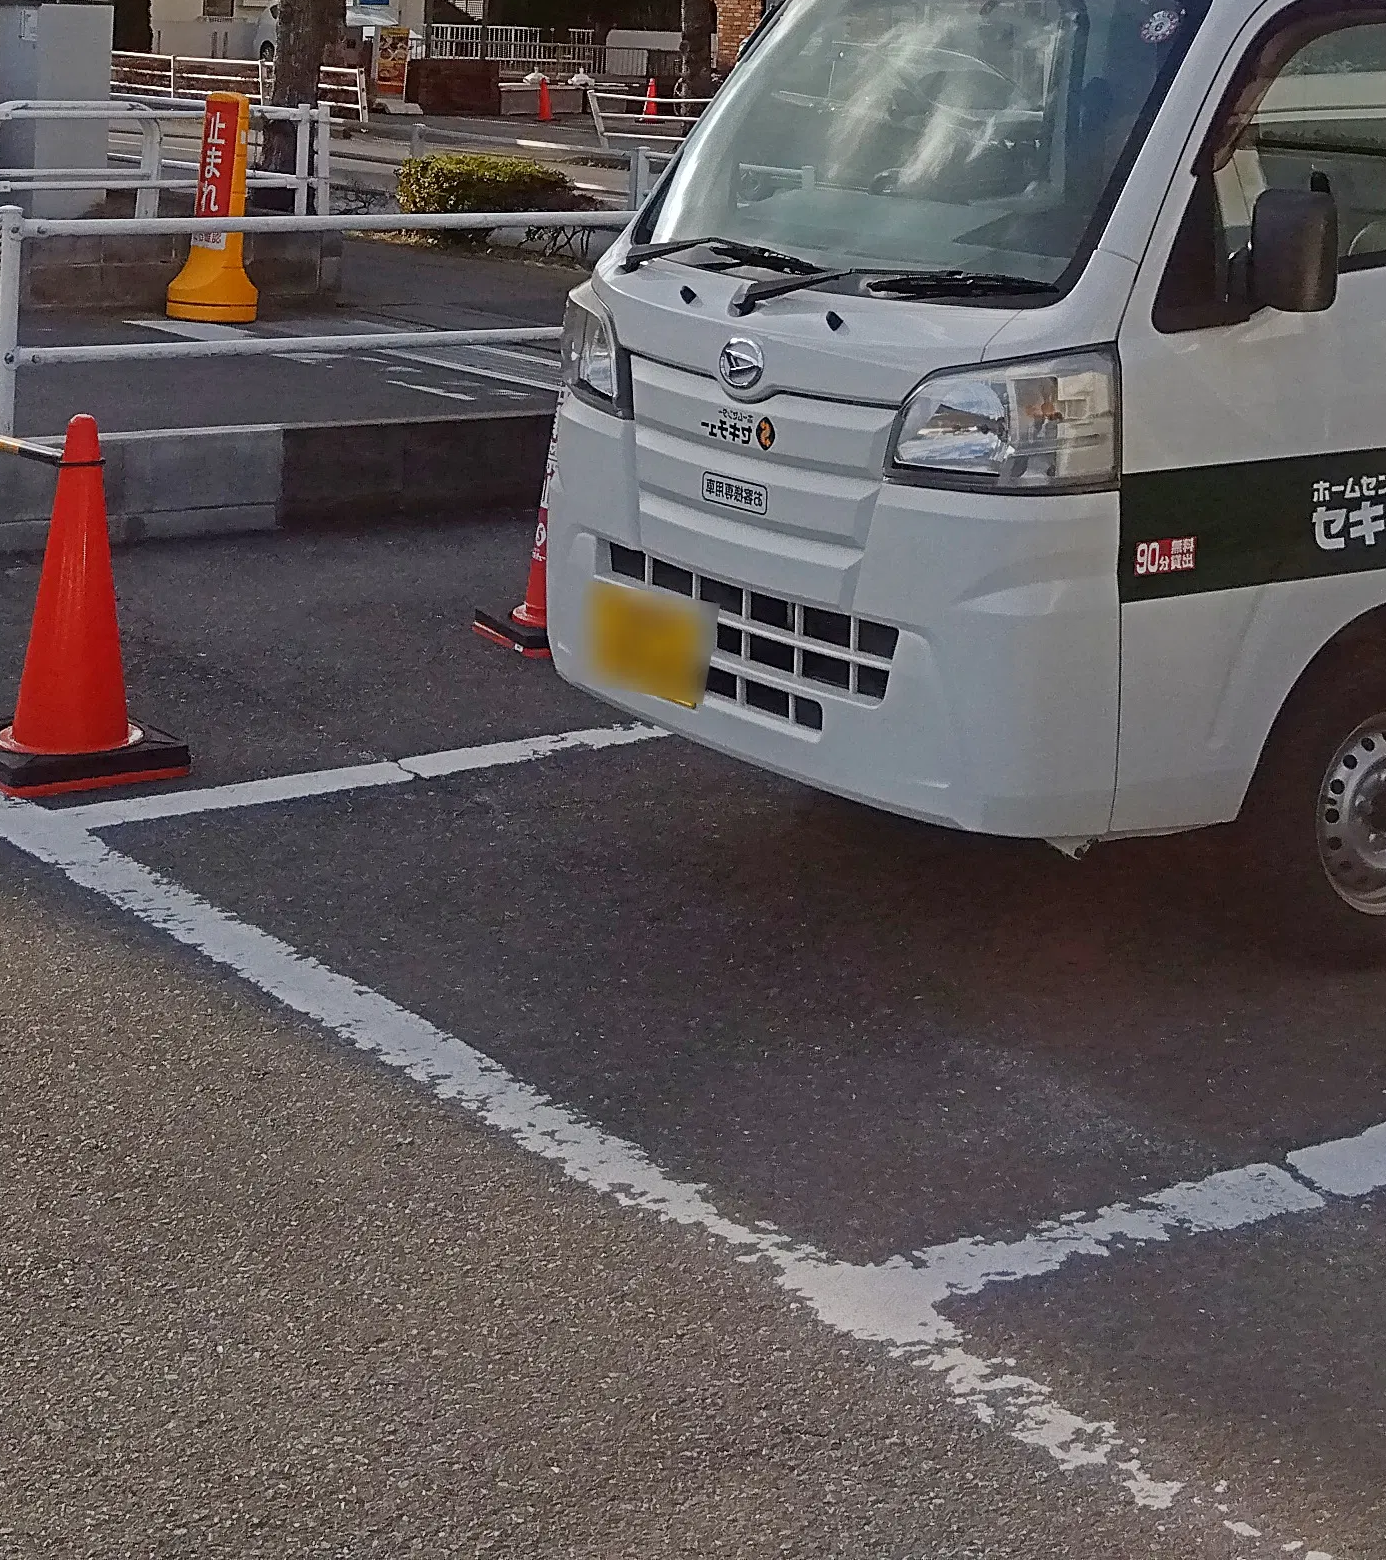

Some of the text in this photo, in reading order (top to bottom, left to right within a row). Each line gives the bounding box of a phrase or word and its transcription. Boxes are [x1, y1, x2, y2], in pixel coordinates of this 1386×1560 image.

[200, 111, 226, 212] 止まれ
[1136, 541, 1170, 574] 90分
